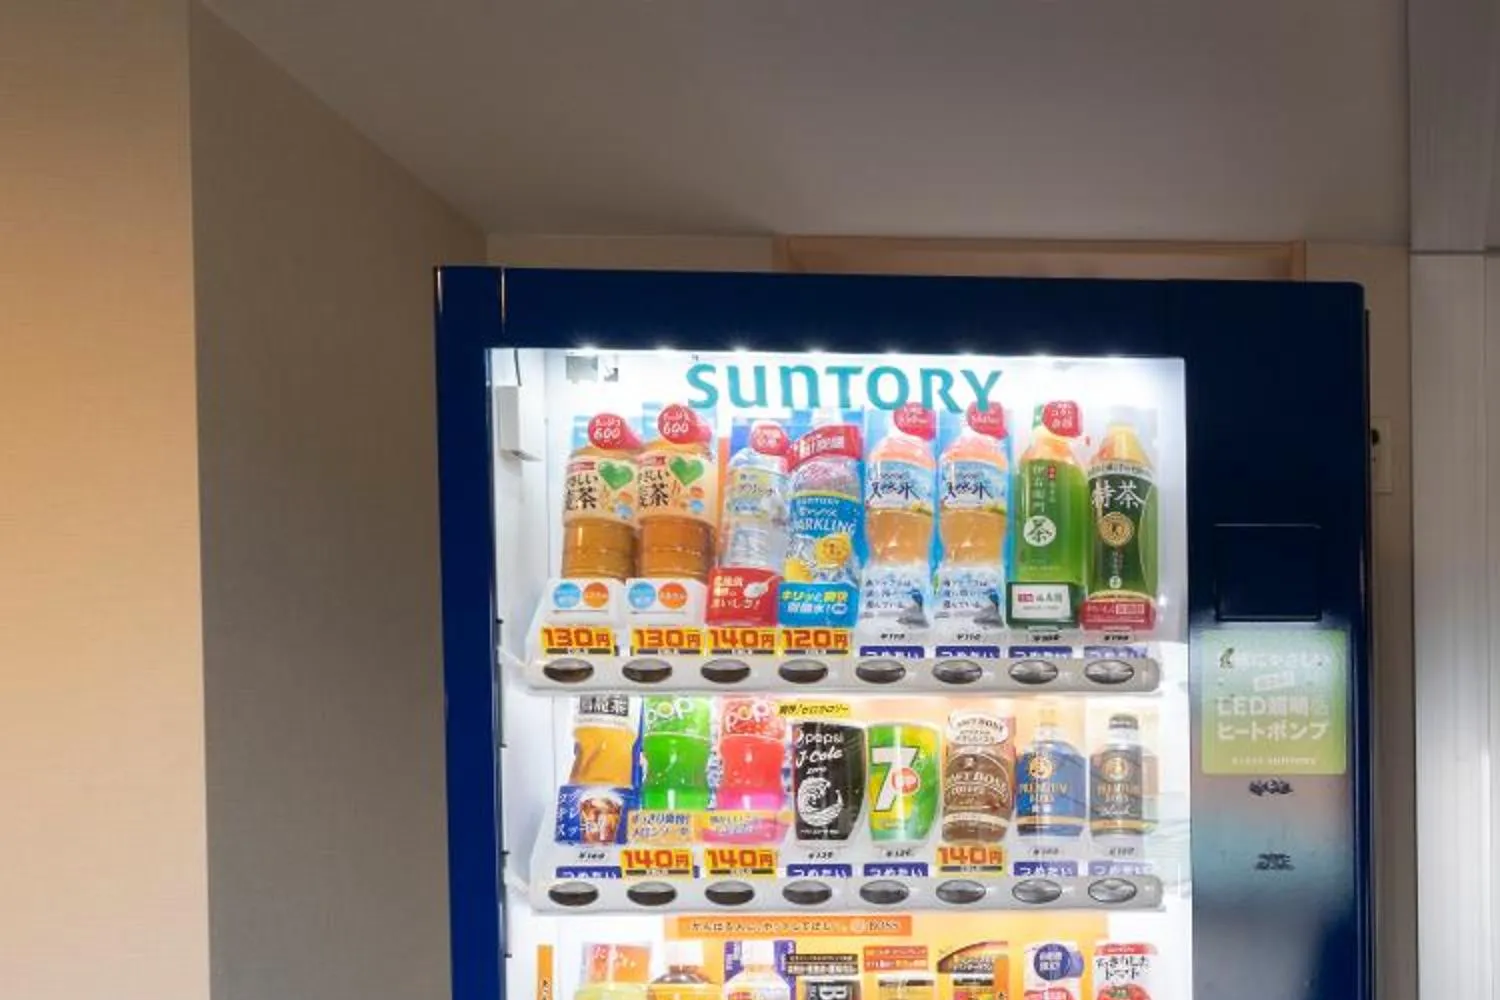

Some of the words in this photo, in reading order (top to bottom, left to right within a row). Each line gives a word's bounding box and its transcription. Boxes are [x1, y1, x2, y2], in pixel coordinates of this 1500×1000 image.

[686, 362, 1003, 414] SUNTORY
[1091, 479, 1146, 509] 特茶
[543, 628, 611, 647] 130円
[634, 629, 701, 647] 130円
[709, 629, 775, 647] 140円
[783, 629, 848, 648] 120円
[1218, 719, 1328, 741] ヒートポンプ
[623, 850, 691, 868] 140円
[708, 850, 774, 868] 140円
[938, 848, 1003, 865] 140円
